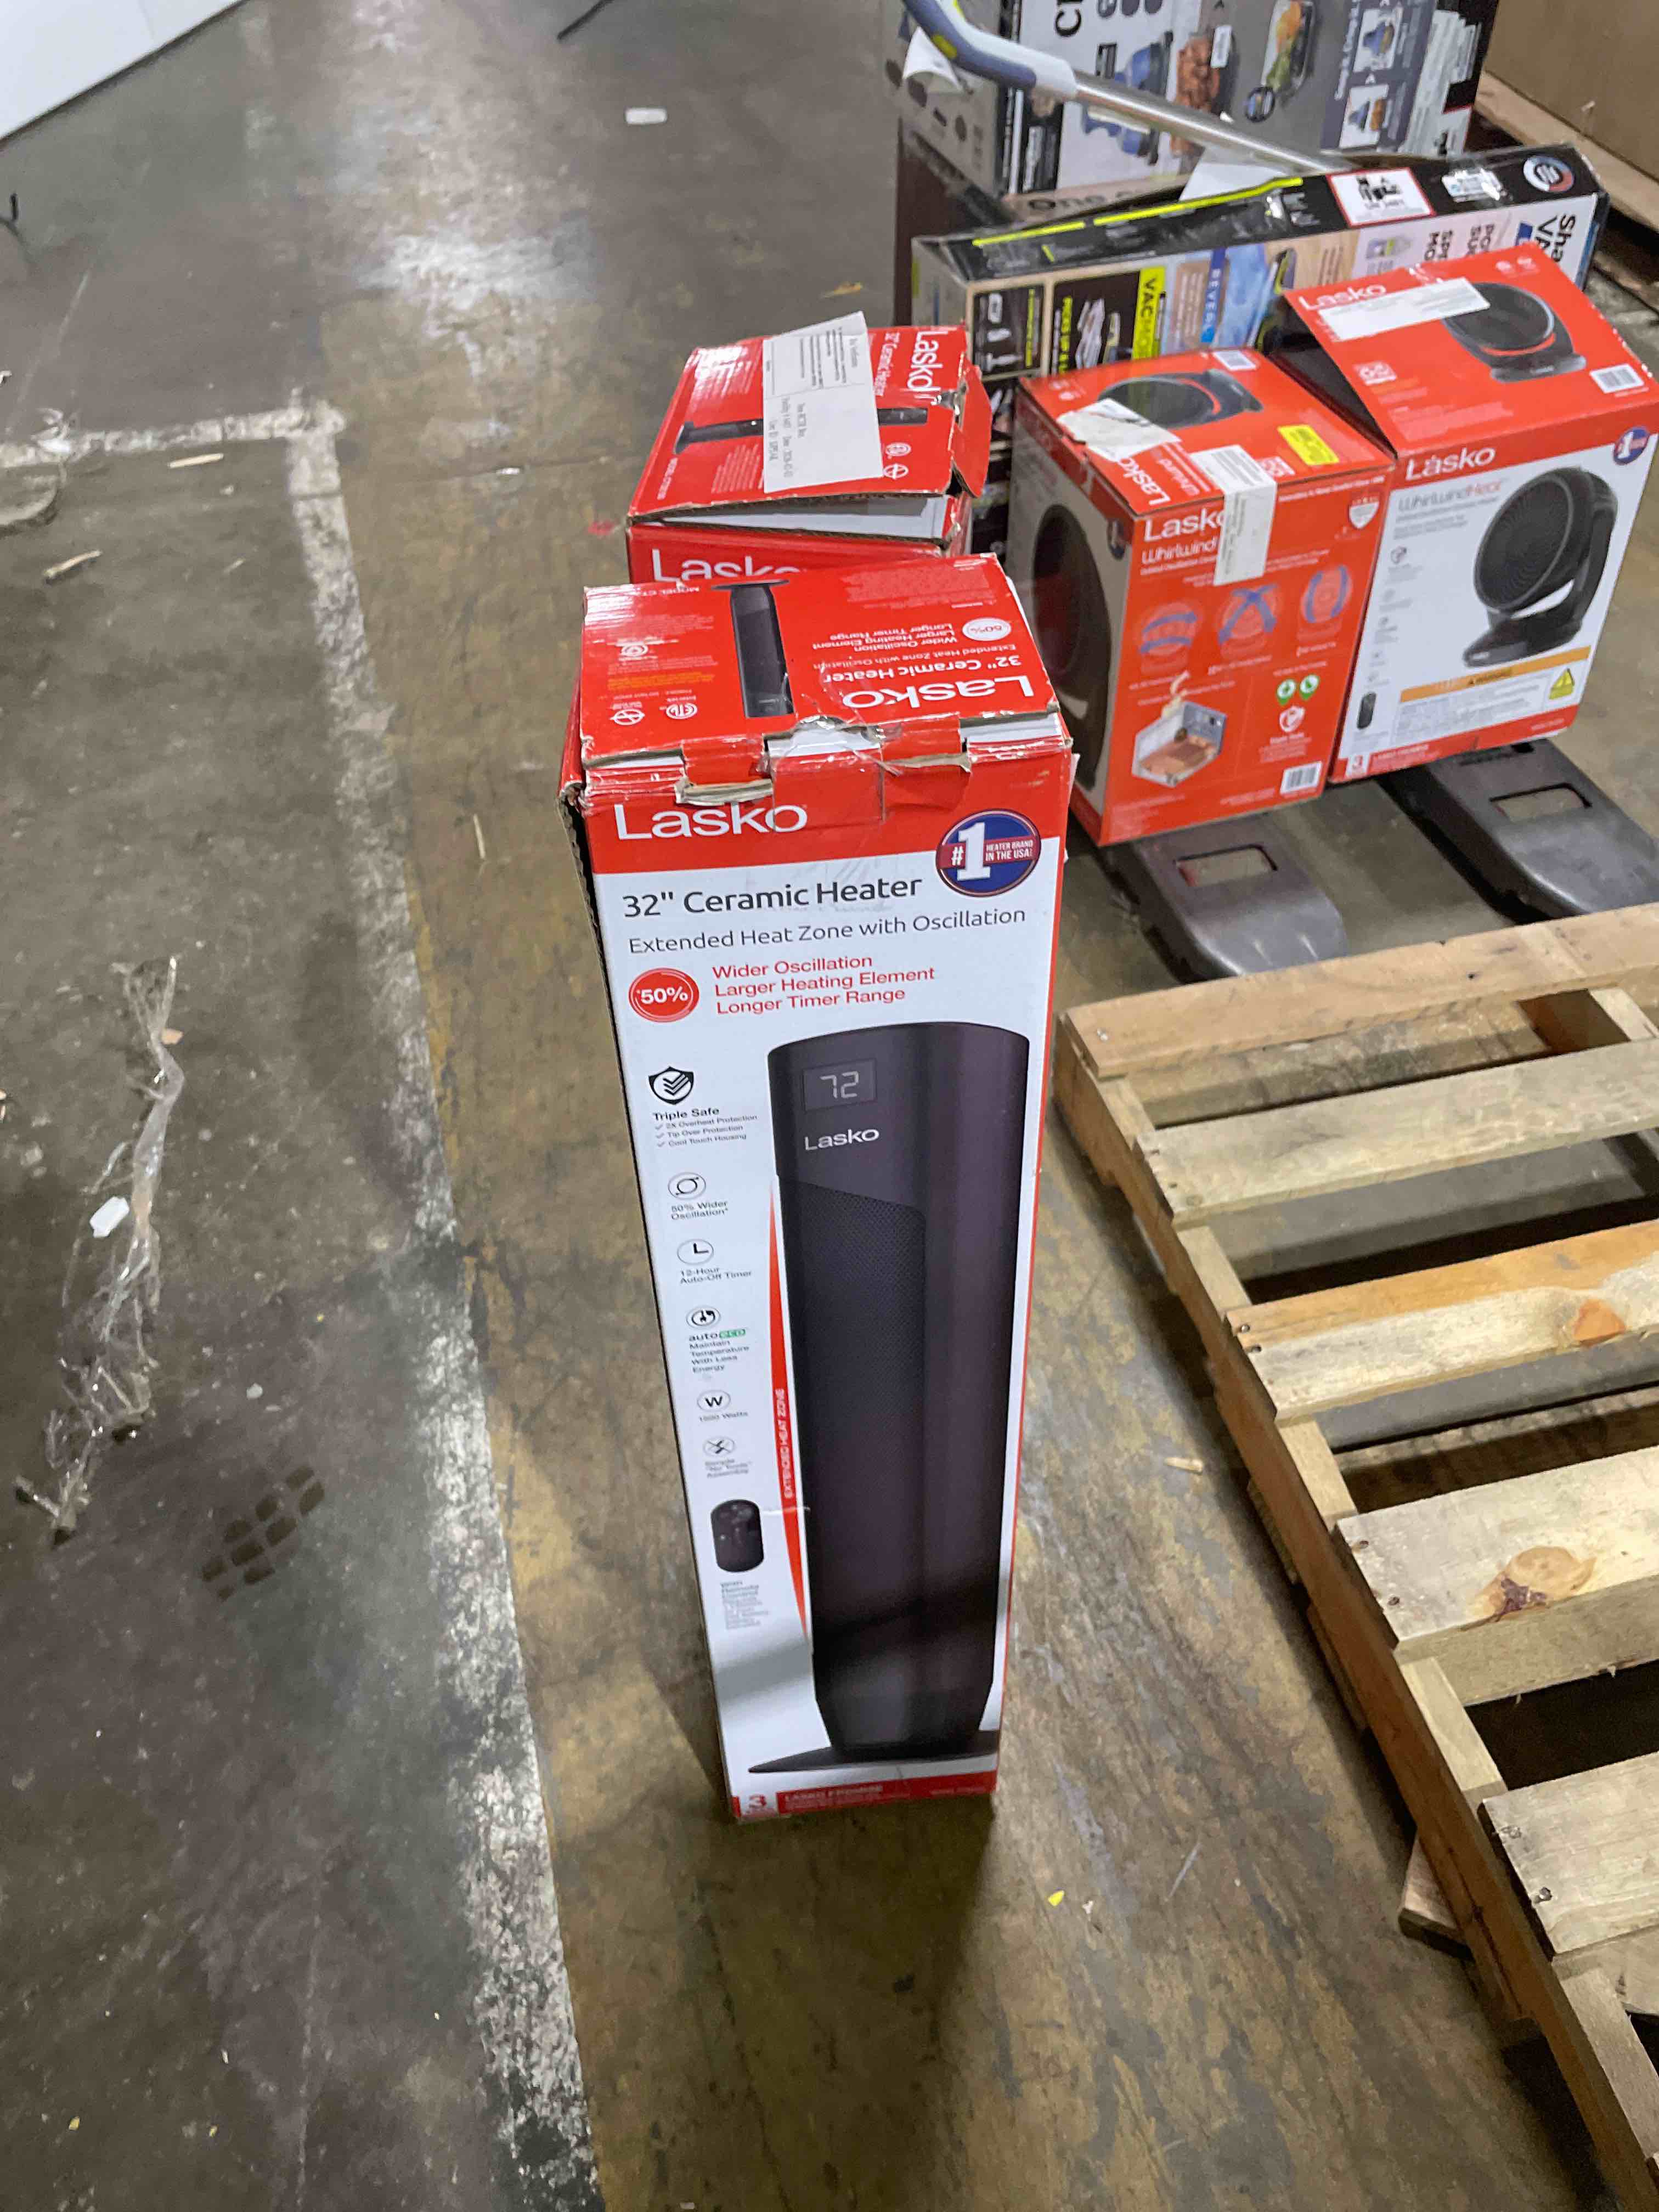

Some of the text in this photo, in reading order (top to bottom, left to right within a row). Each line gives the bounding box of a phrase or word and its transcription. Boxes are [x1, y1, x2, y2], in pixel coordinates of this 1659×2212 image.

[1551, 215, 1576, 262] Sha
[1299, 285, 1386, 311] Lasko
[907, 331, 948, 391] Lasko
[1406, 448, 1496, 481] Lasko
[1118, 457, 1171, 505] Lasko
[652, 549, 800, 582] Lask
[823, 655, 1022, 683] 32" Ceramic Heater
[843, 675, 1034, 708] Lasko
[614, 802, 808, 840] Lasko
[951, 822, 991, 882] #1
[985, 853, 994, 861] IN
[996, 850, 1011, 860] THE
[986, 840, 1033, 851] HEATER BRAND
[622, 878, 922, 918] 32" Ceramic Heater
[629, 909, 1025, 953] Extended Heat Zone with Oscillation
[712, 956, 873, 979] Wider Oscillation
[715, 967, 935, 998] Larger Heating Element
[717, 989, 905, 1014] Longer Timer Range
[820, 1071, 859, 1099] 72
[653, 1107, 720, 1121] Triple Safe
[716, 1115, 758, 1124] Protection
[703, 1125, 743, 1134] Protection
[805, 1128, 879, 1150] Lasko
[697, 1201, 728, 1209] Wider
